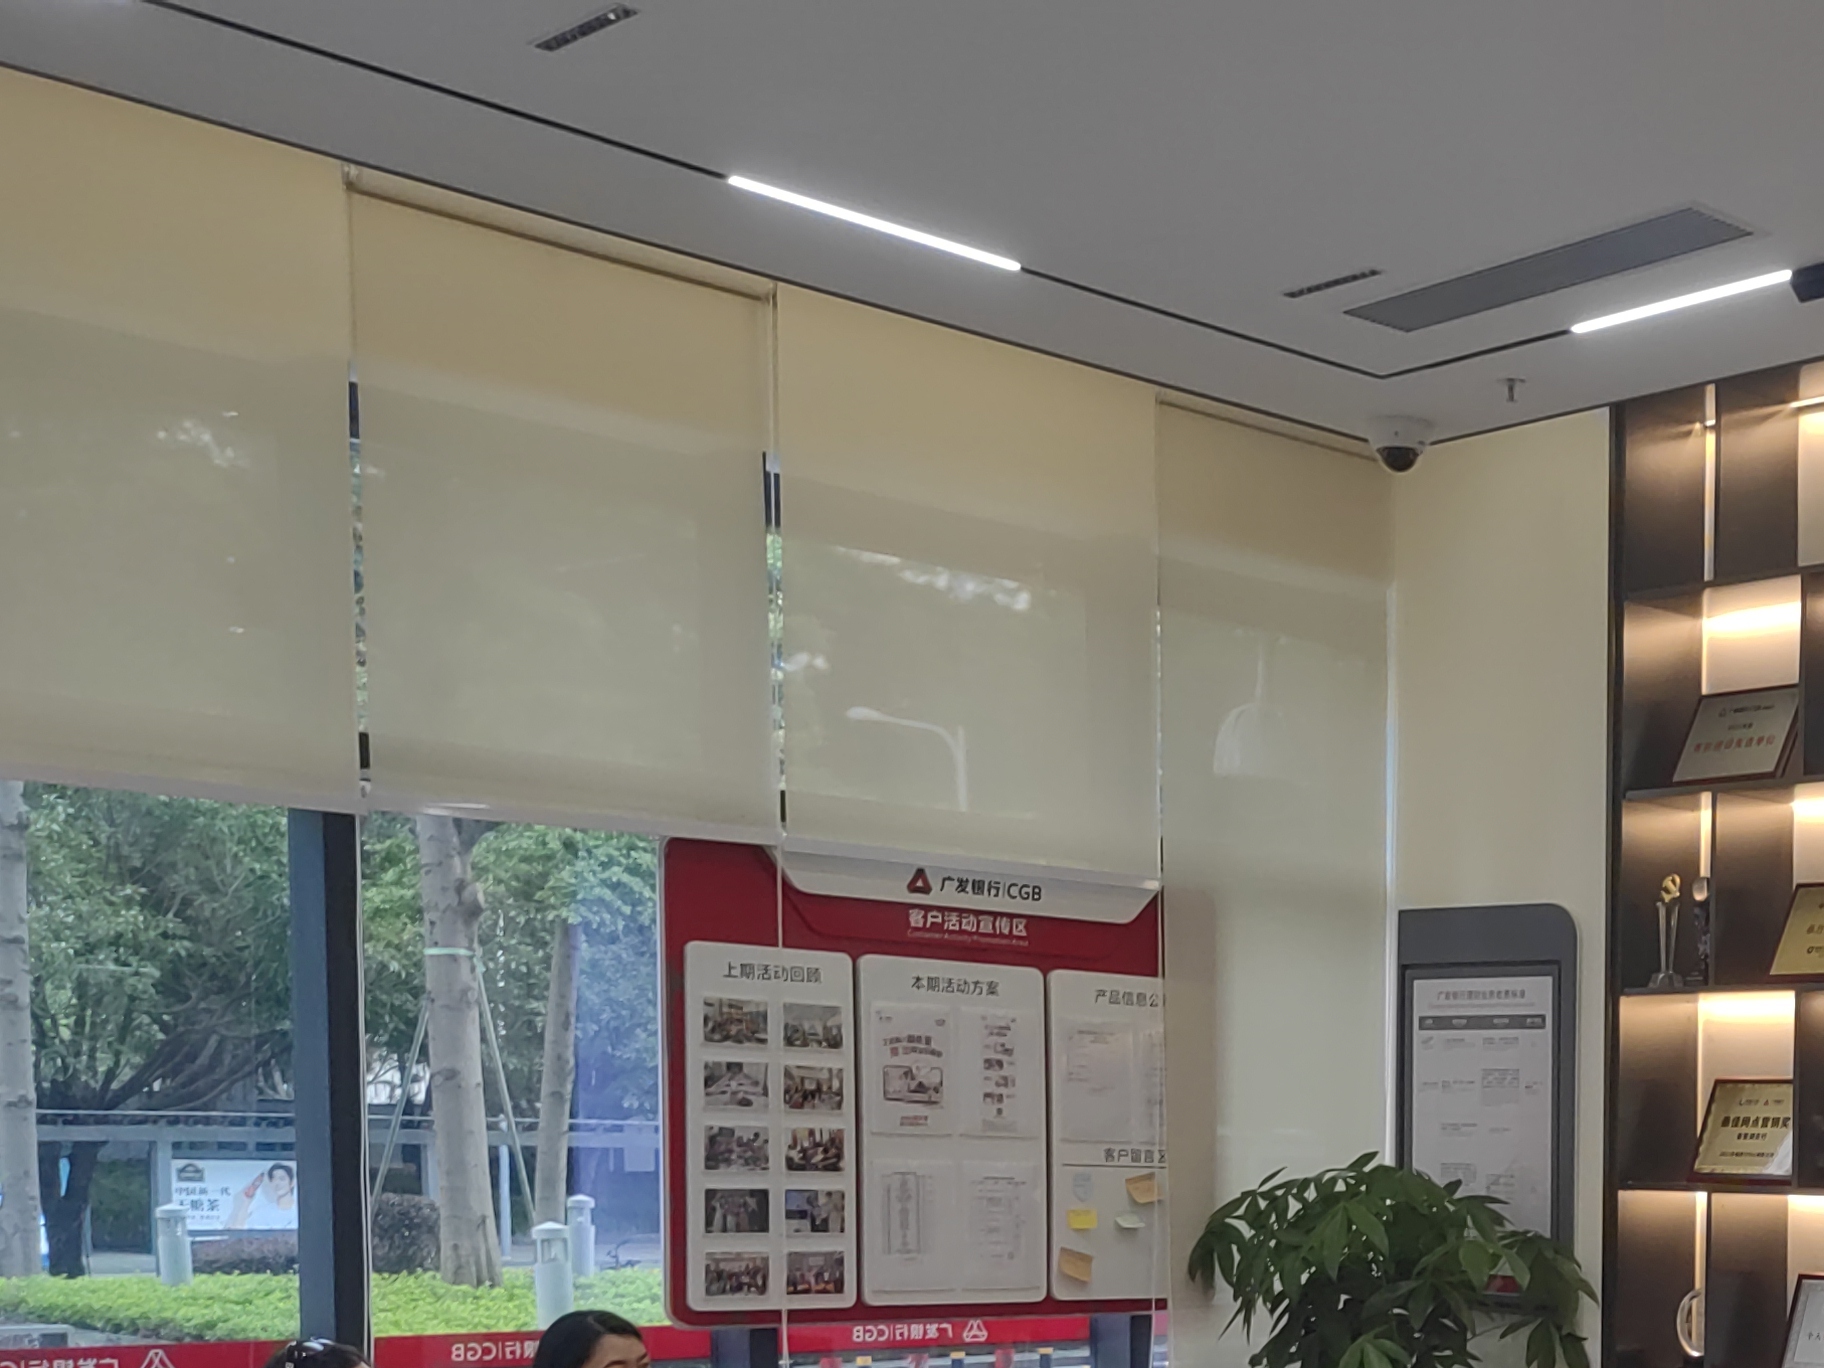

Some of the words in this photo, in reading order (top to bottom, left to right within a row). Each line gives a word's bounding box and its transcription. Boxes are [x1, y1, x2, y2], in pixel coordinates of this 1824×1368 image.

[908, 907, 1028, 937] 客户活动宣传区
[722, 960, 823, 984] 上期活动回顾
[911, 974, 1000, 997] 本期活动方案
[1094, 988, 1167, 1008] 产品信息公
